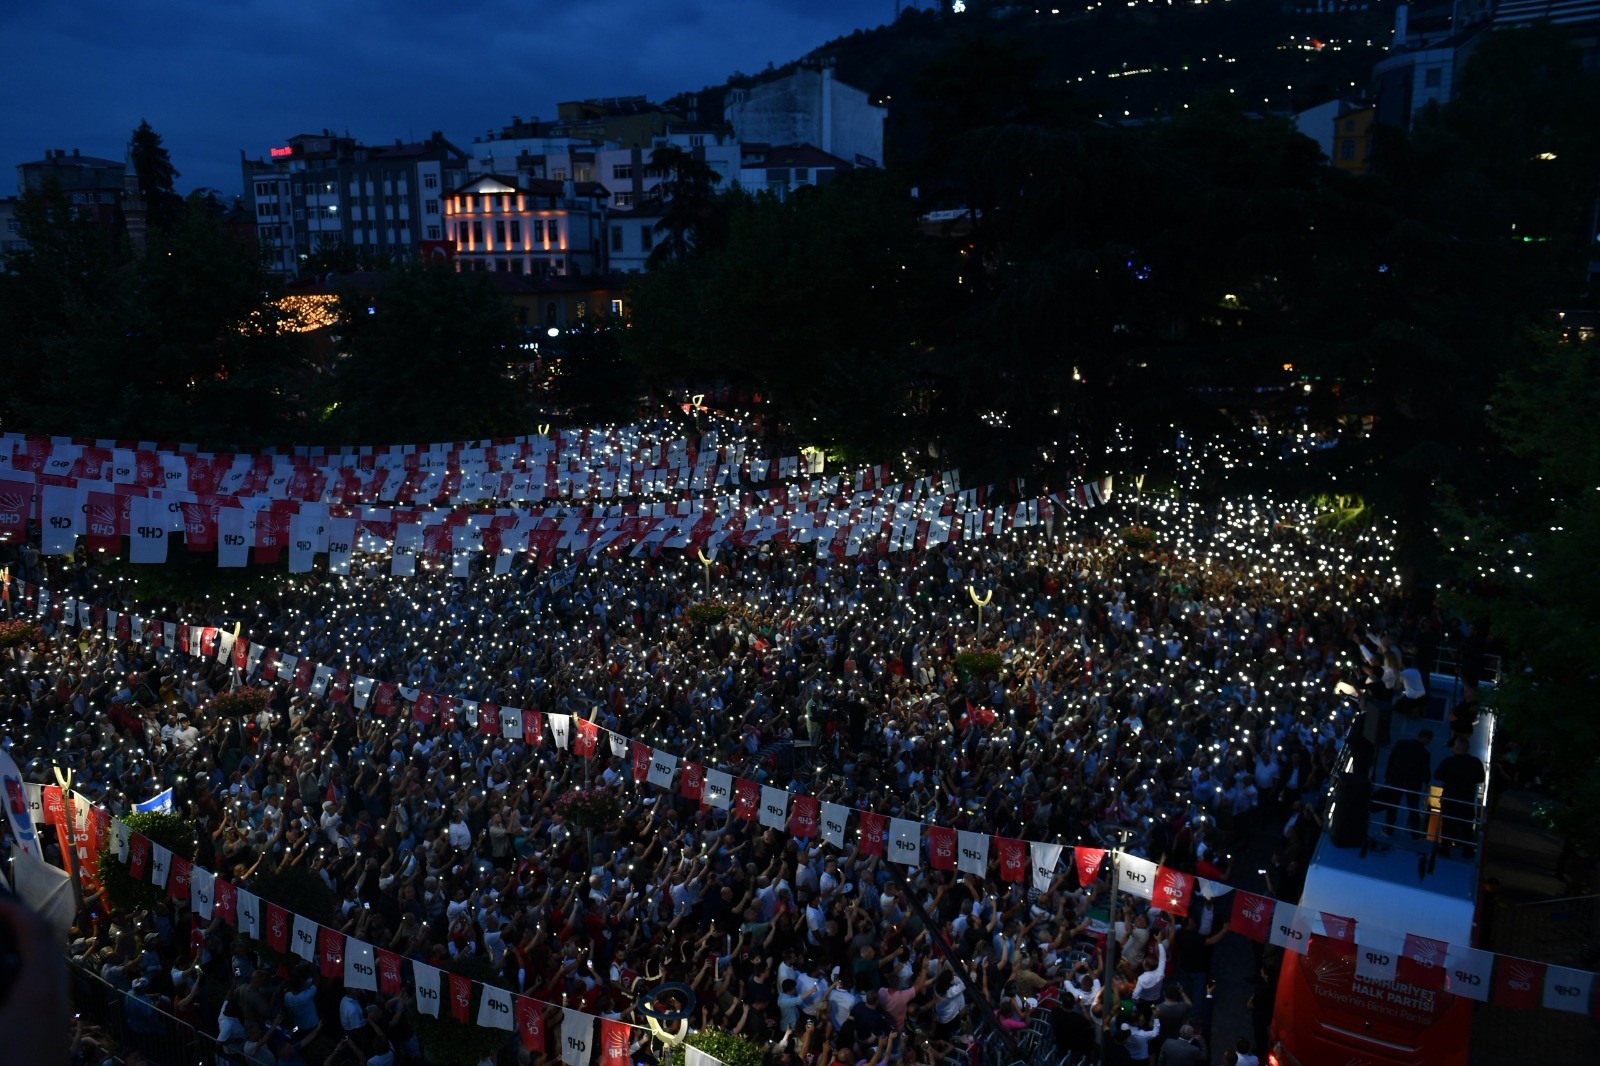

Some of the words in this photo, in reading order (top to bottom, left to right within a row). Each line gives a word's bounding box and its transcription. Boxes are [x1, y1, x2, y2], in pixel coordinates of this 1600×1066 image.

[330, 543, 348, 553] CHP
[1314, 984, 1365, 1008] Türkiye'nin
[1367, 1000, 1398, 1016] Birinci
[1400, 1009, 1432, 1025] Partisi
[1352, 983, 1383, 999] HALK
[1387, 992, 1434, 1012] PARTİSİ
